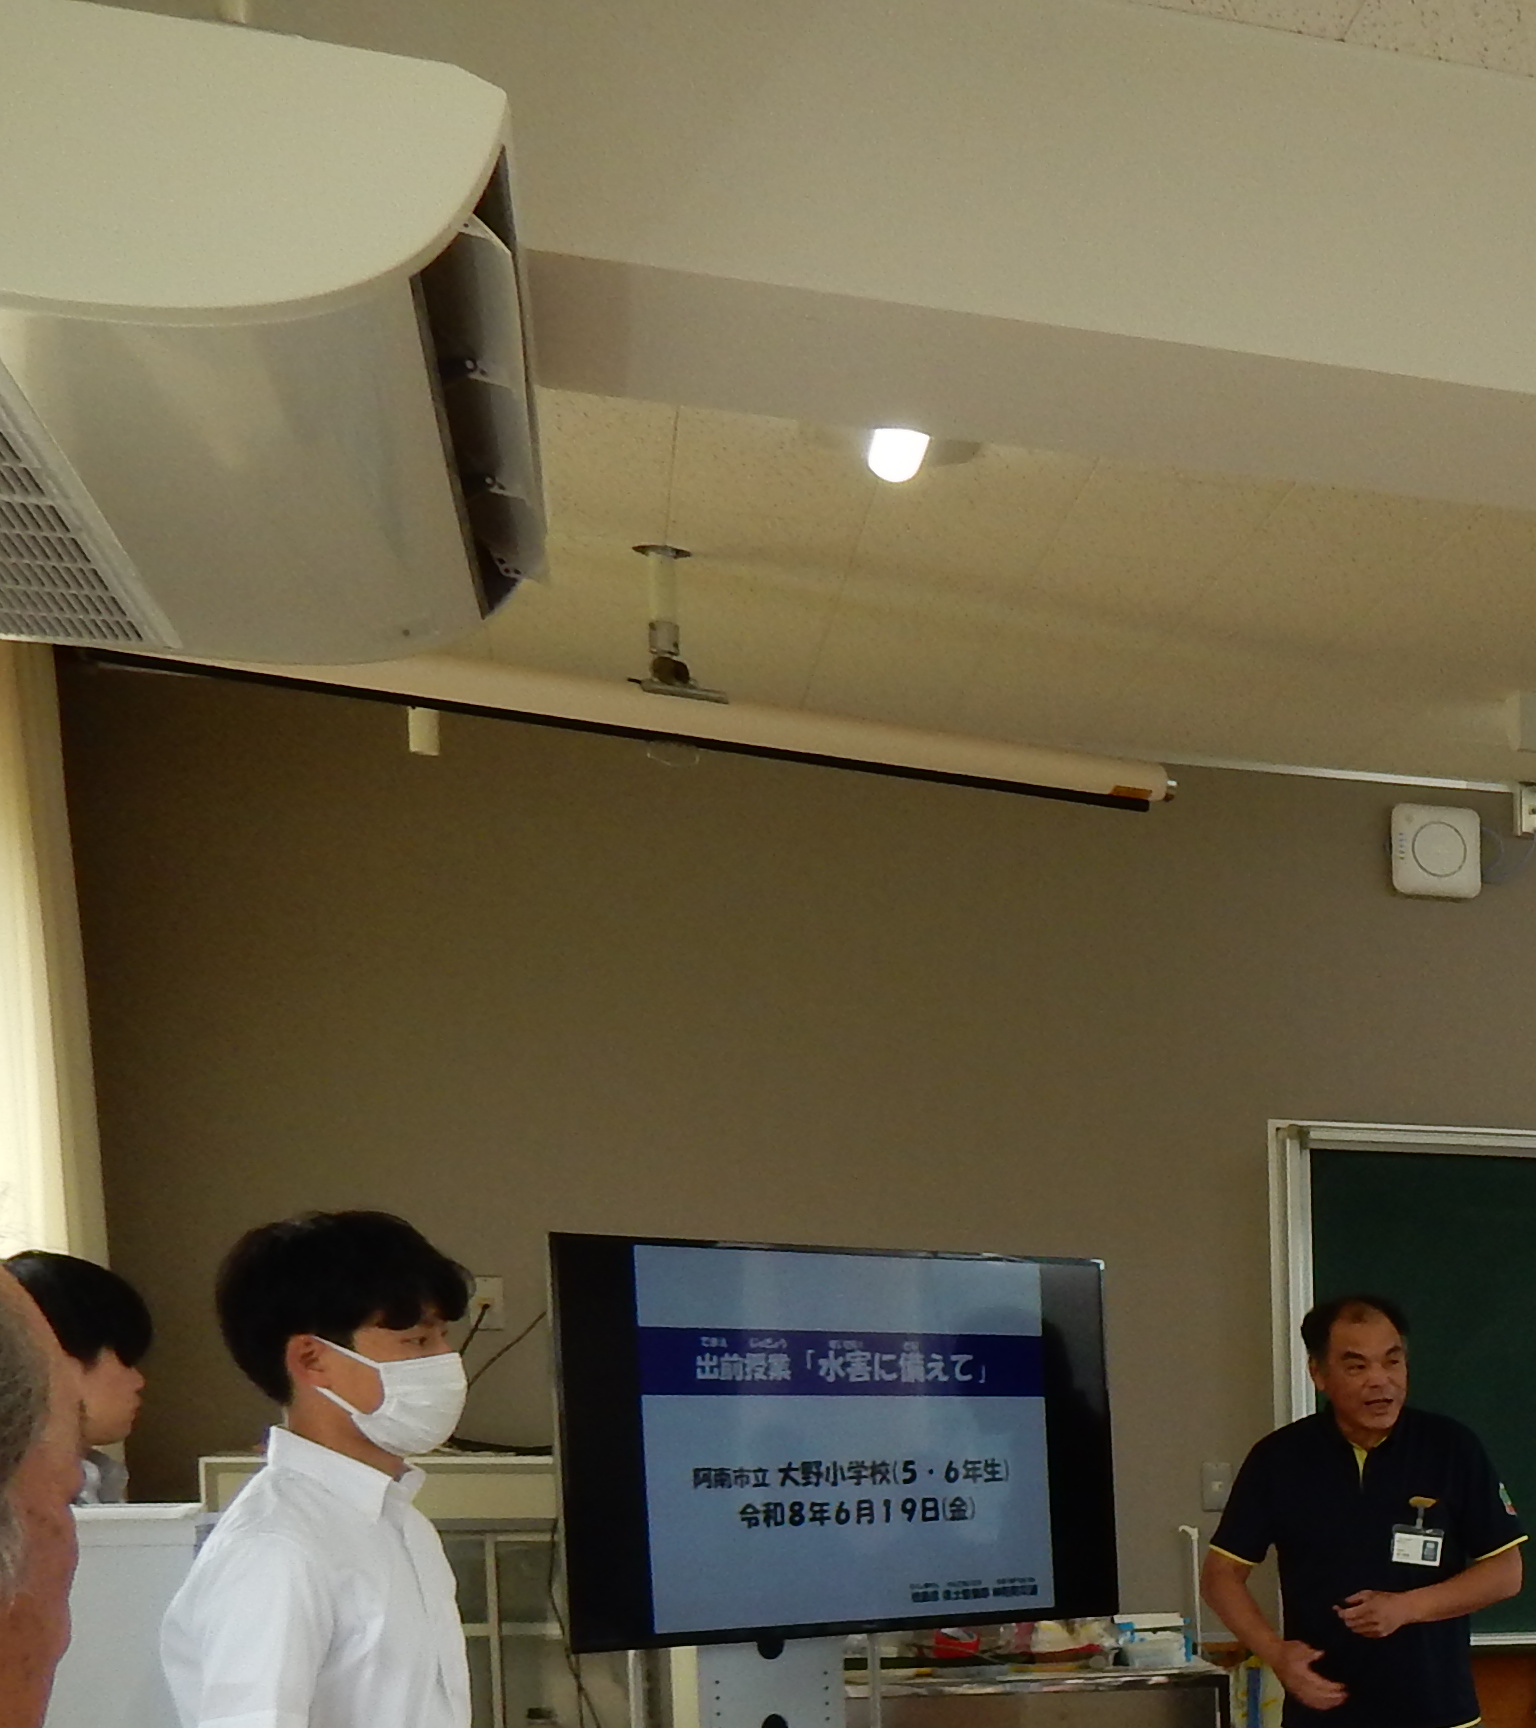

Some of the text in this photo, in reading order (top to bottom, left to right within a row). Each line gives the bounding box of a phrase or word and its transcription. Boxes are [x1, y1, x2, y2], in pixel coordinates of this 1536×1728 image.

[692, 1467, 770, 1489] 阿南市立
[738, 1496, 977, 1530] 令和8年6月19日(金)
